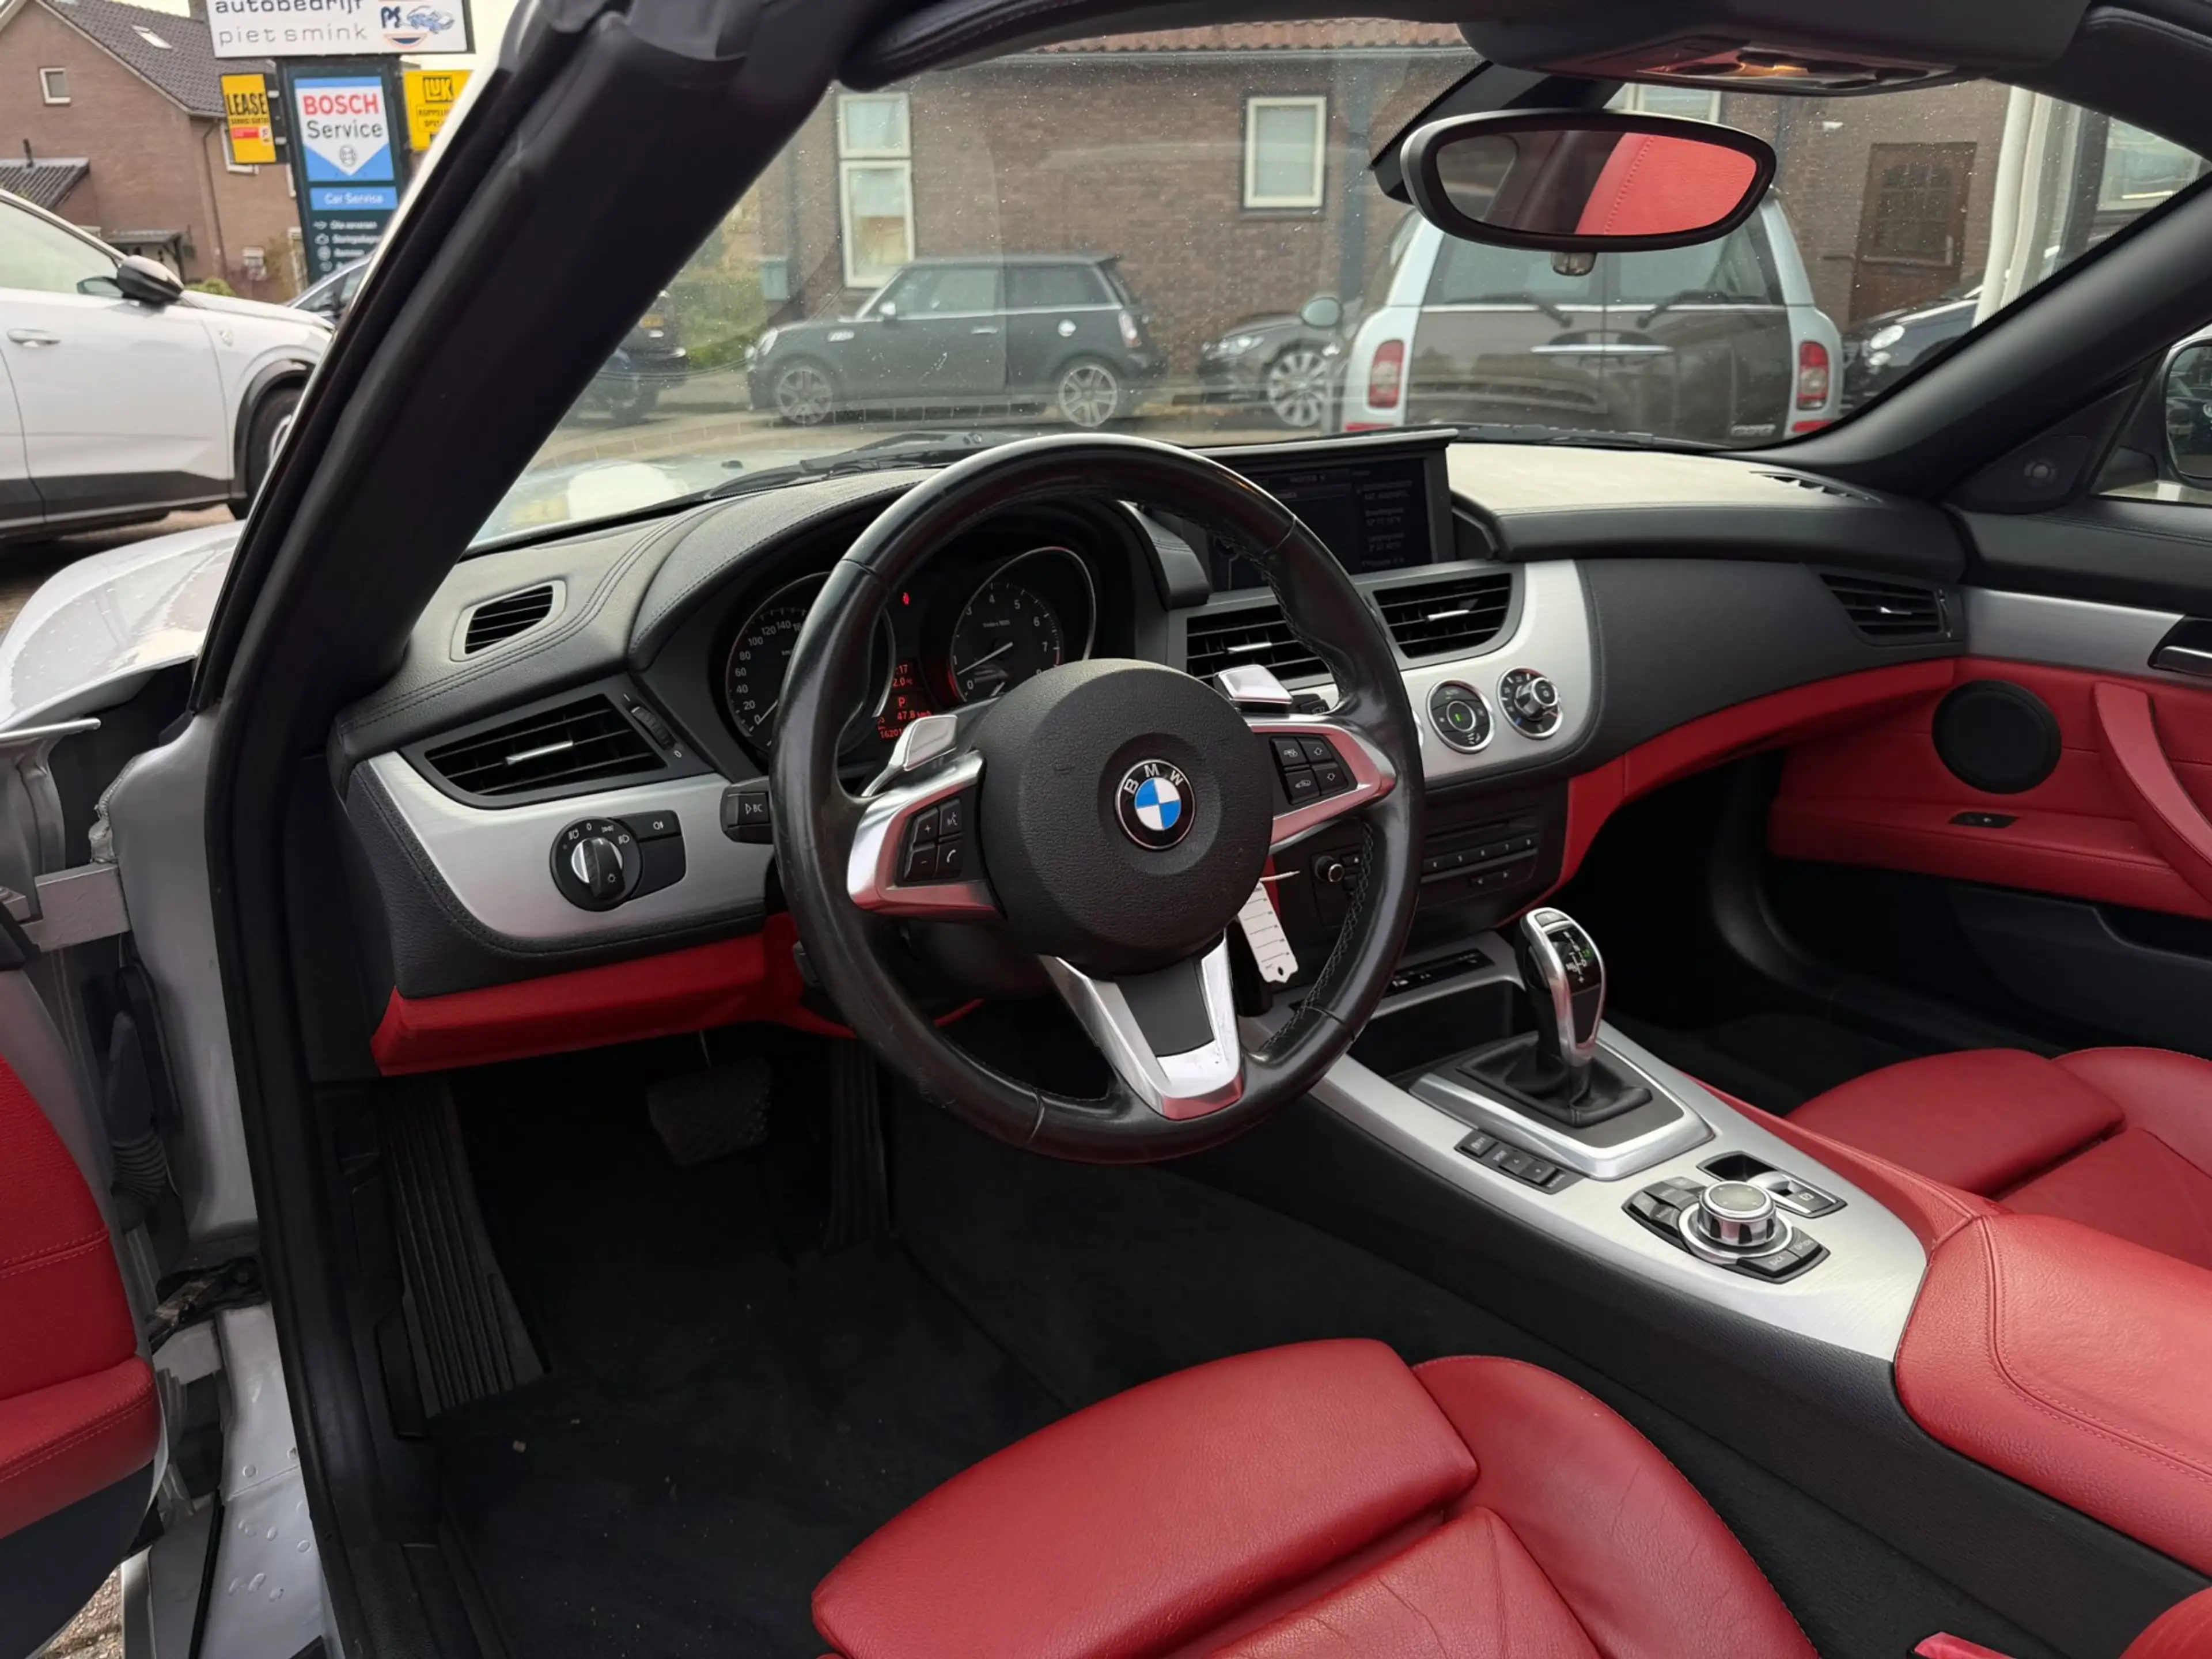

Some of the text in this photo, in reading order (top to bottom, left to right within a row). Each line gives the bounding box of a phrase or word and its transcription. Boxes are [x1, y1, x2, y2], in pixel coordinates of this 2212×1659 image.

[219, 22, 368, 48] piet smink
[226, 93, 268, 115] LEASE
[303, 93, 378, 115] BOSCH
[306, 119, 382, 139] Service
[989, 594, 995, 604] 4
[1014, 599, 1020, 609] 5
[776, 620, 791, 630] 140
[1033, 616, 1040, 627] 6
[761, 625, 777, 636] 120
[748, 636, 763, 646] 100
[1041, 641, 1048, 652] 7
[739, 651, 751, 661] 80
[735, 668, 747, 677] 60
[736, 684, 748, 694] 40
[966, 680, 974, 690] 0
[743, 700, 756, 710] 20
[898, 696, 906, 707] P
[754, 714, 761, 724] 0
[1123, 763, 1184, 795] BMW
